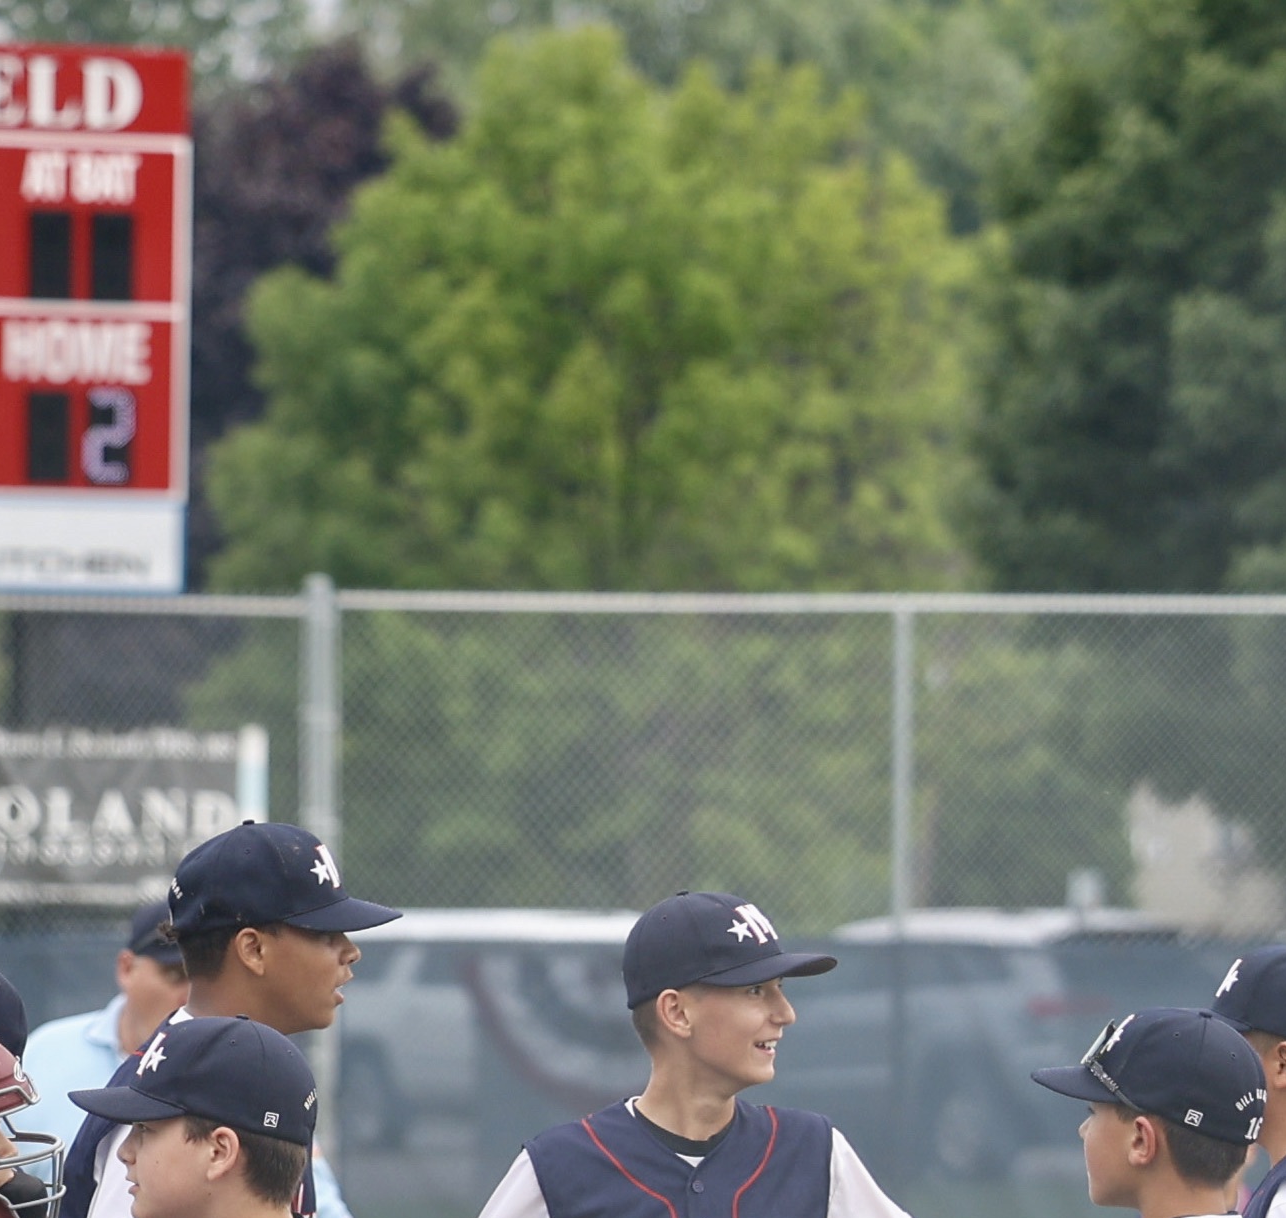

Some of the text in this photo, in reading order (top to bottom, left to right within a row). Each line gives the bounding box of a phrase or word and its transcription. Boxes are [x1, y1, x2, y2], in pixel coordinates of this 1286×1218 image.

[22, 151, 141, 204] AT BAT
[1, 318, 152, 386] HOME
[81, 387, 138, 486] 2
